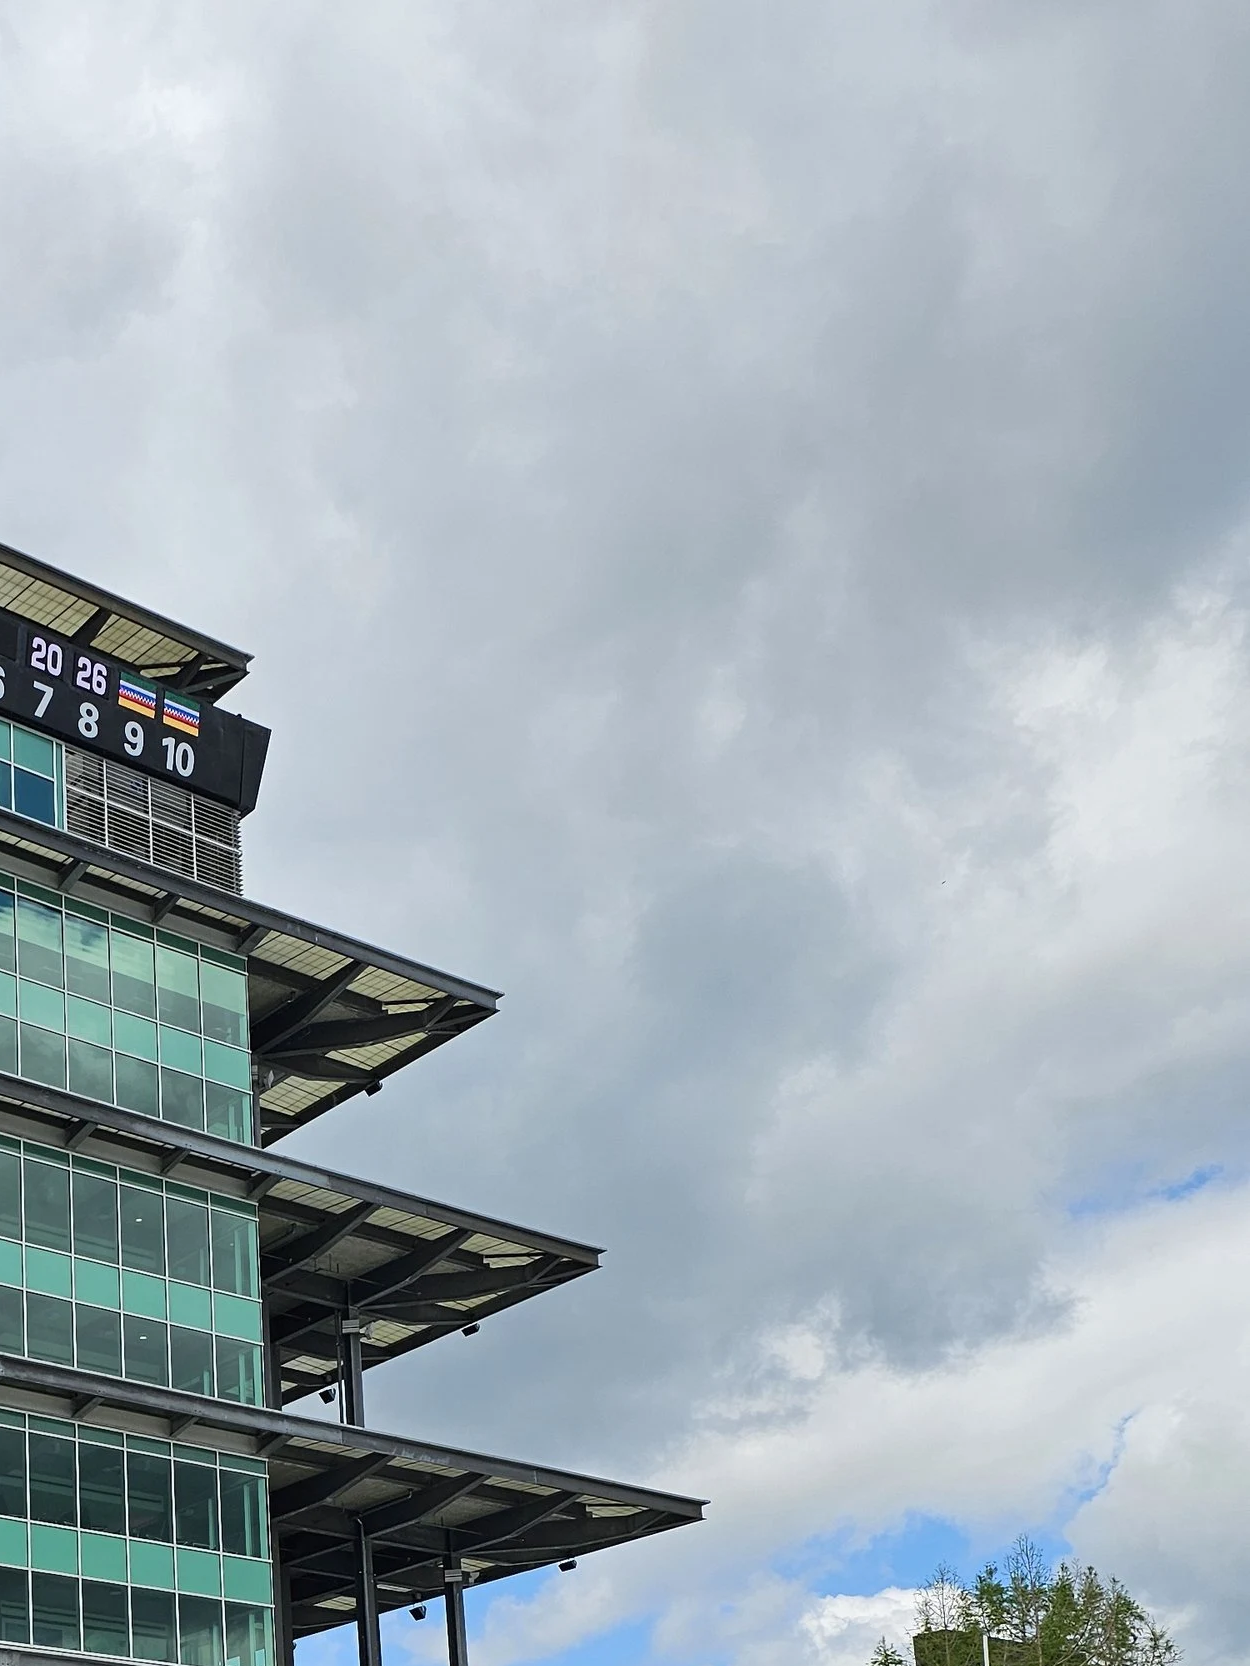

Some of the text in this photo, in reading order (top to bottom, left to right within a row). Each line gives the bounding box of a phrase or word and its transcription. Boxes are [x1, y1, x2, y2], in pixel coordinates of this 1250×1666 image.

[31, 636, 63, 677] 20
[76, 656, 108, 696] 26
[33, 680, 55, 718] 7
[77, 701, 100, 739] 8
[123, 720, 145, 757] 9
[161, 736, 195, 778] 10
